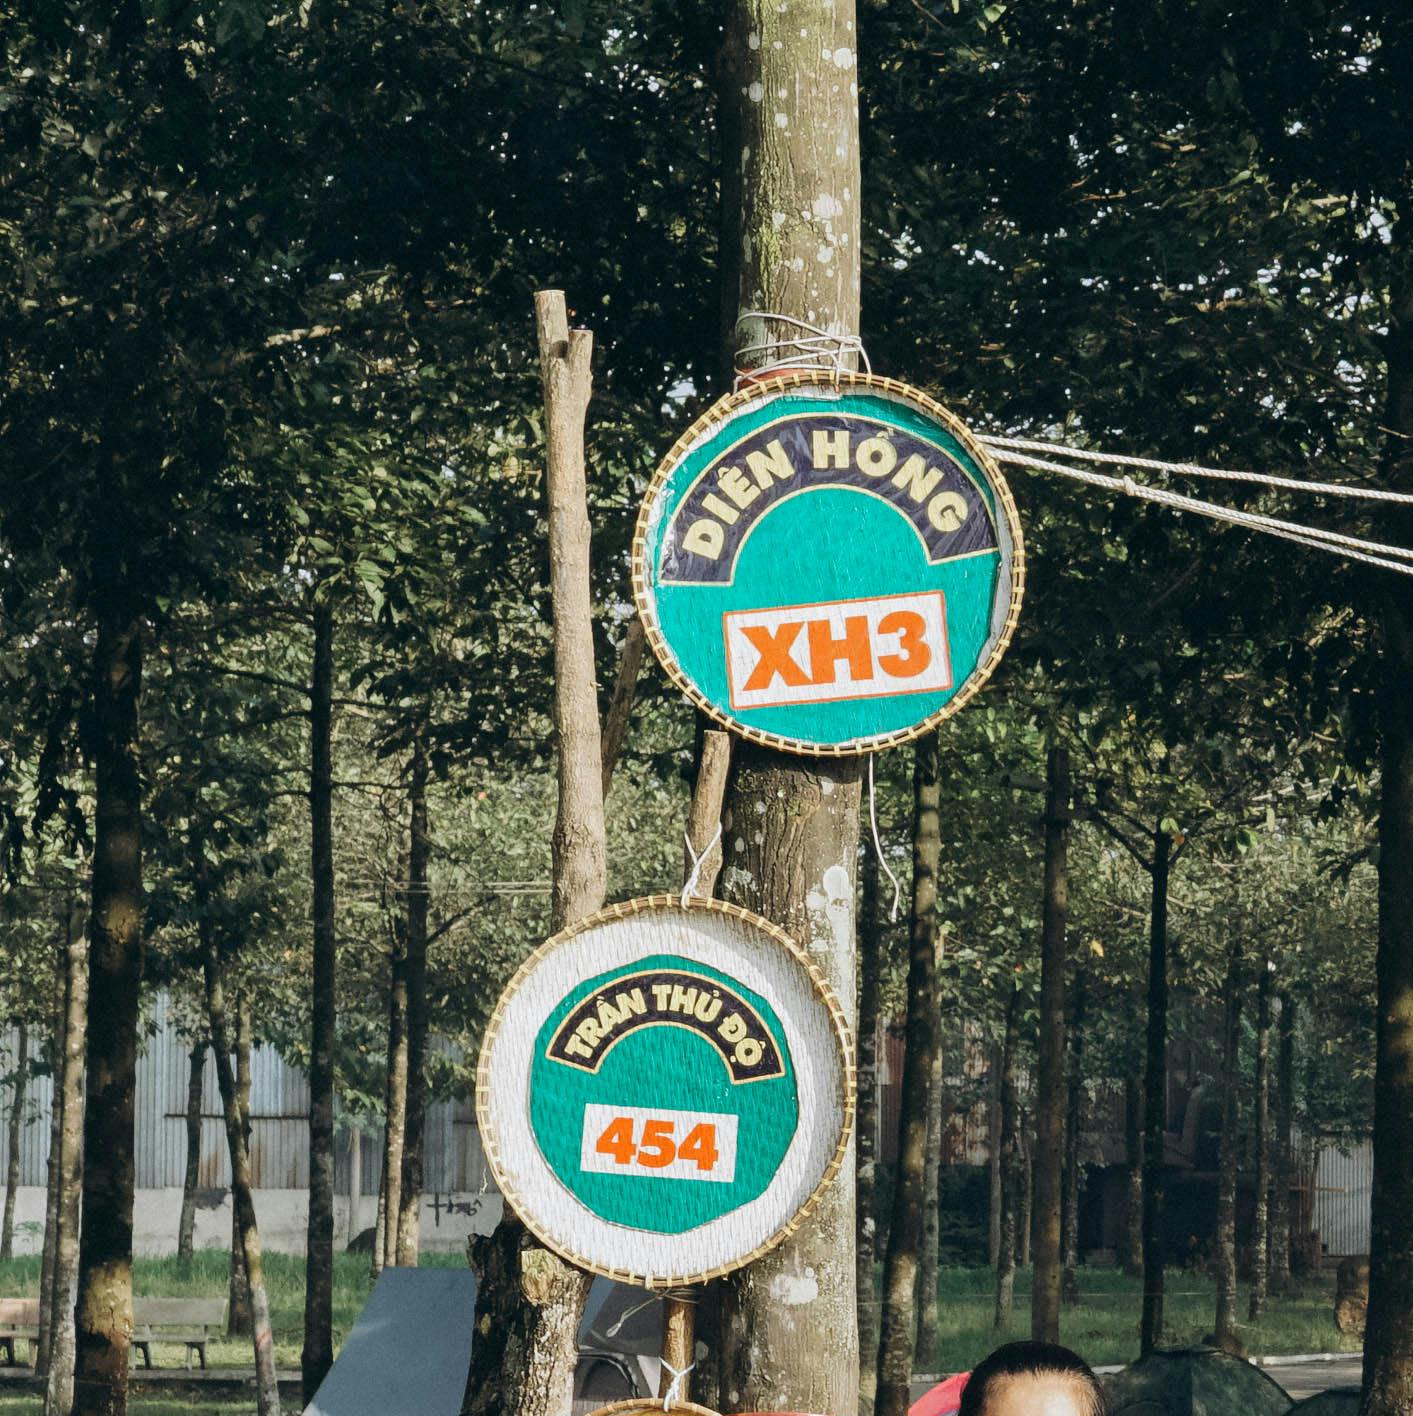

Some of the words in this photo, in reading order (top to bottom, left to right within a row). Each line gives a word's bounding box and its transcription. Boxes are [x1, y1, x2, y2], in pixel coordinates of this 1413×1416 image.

[738, 610, 932, 692] XH3
[564, 987, 648, 1059] TRẦN
[651, 984, 724, 1022] THỦ
[717, 1011, 767, 1067] ĐỘ
[595, 1117, 719, 1172] 454
